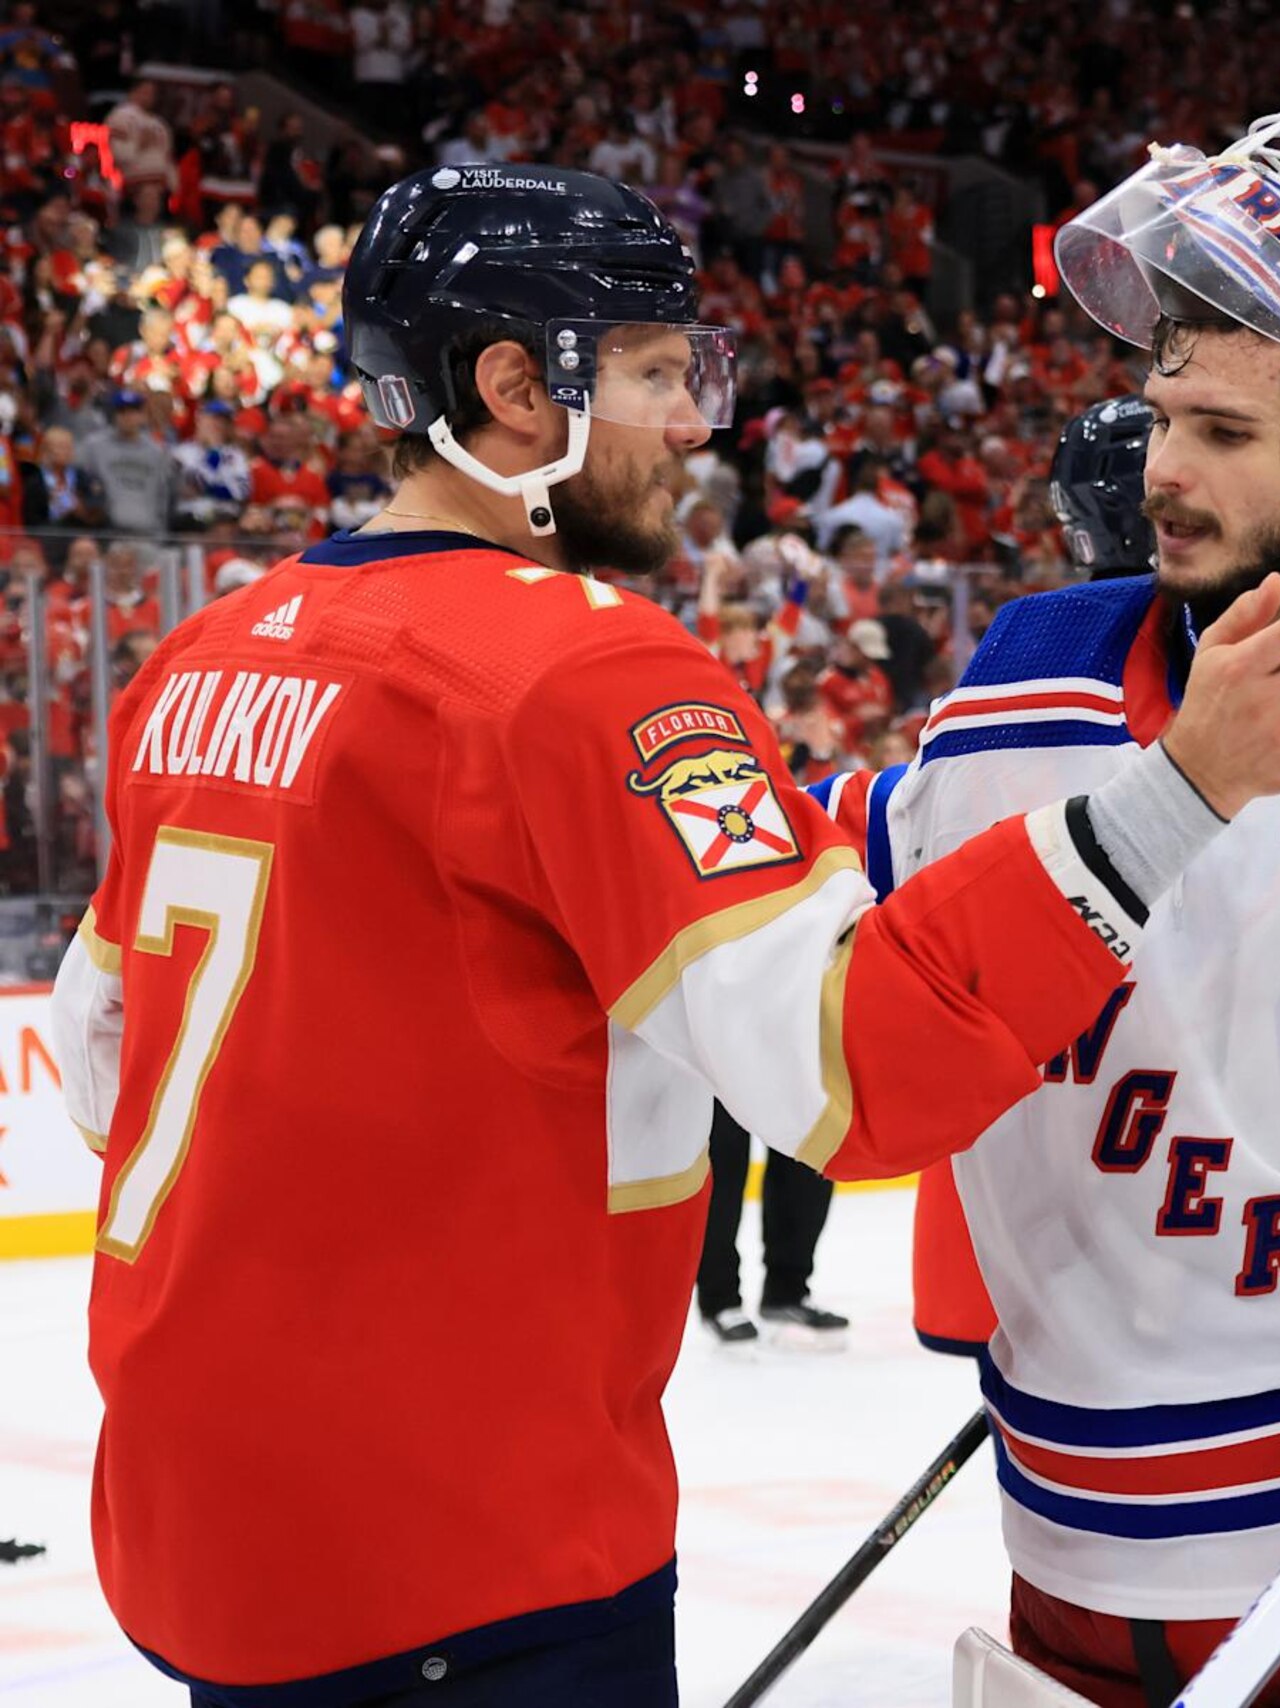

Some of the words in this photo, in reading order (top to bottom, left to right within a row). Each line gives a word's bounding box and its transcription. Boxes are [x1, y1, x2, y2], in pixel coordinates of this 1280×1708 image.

[461, 178, 567, 192] LAUDERDALE
[463, 169, 501, 178] VISIT
[251, 622, 295, 640] adidas
[132, 670, 342, 789] KULIKOV
[646, 711, 729, 746] FLORIDA
[98, 825, 275, 1266] 7
